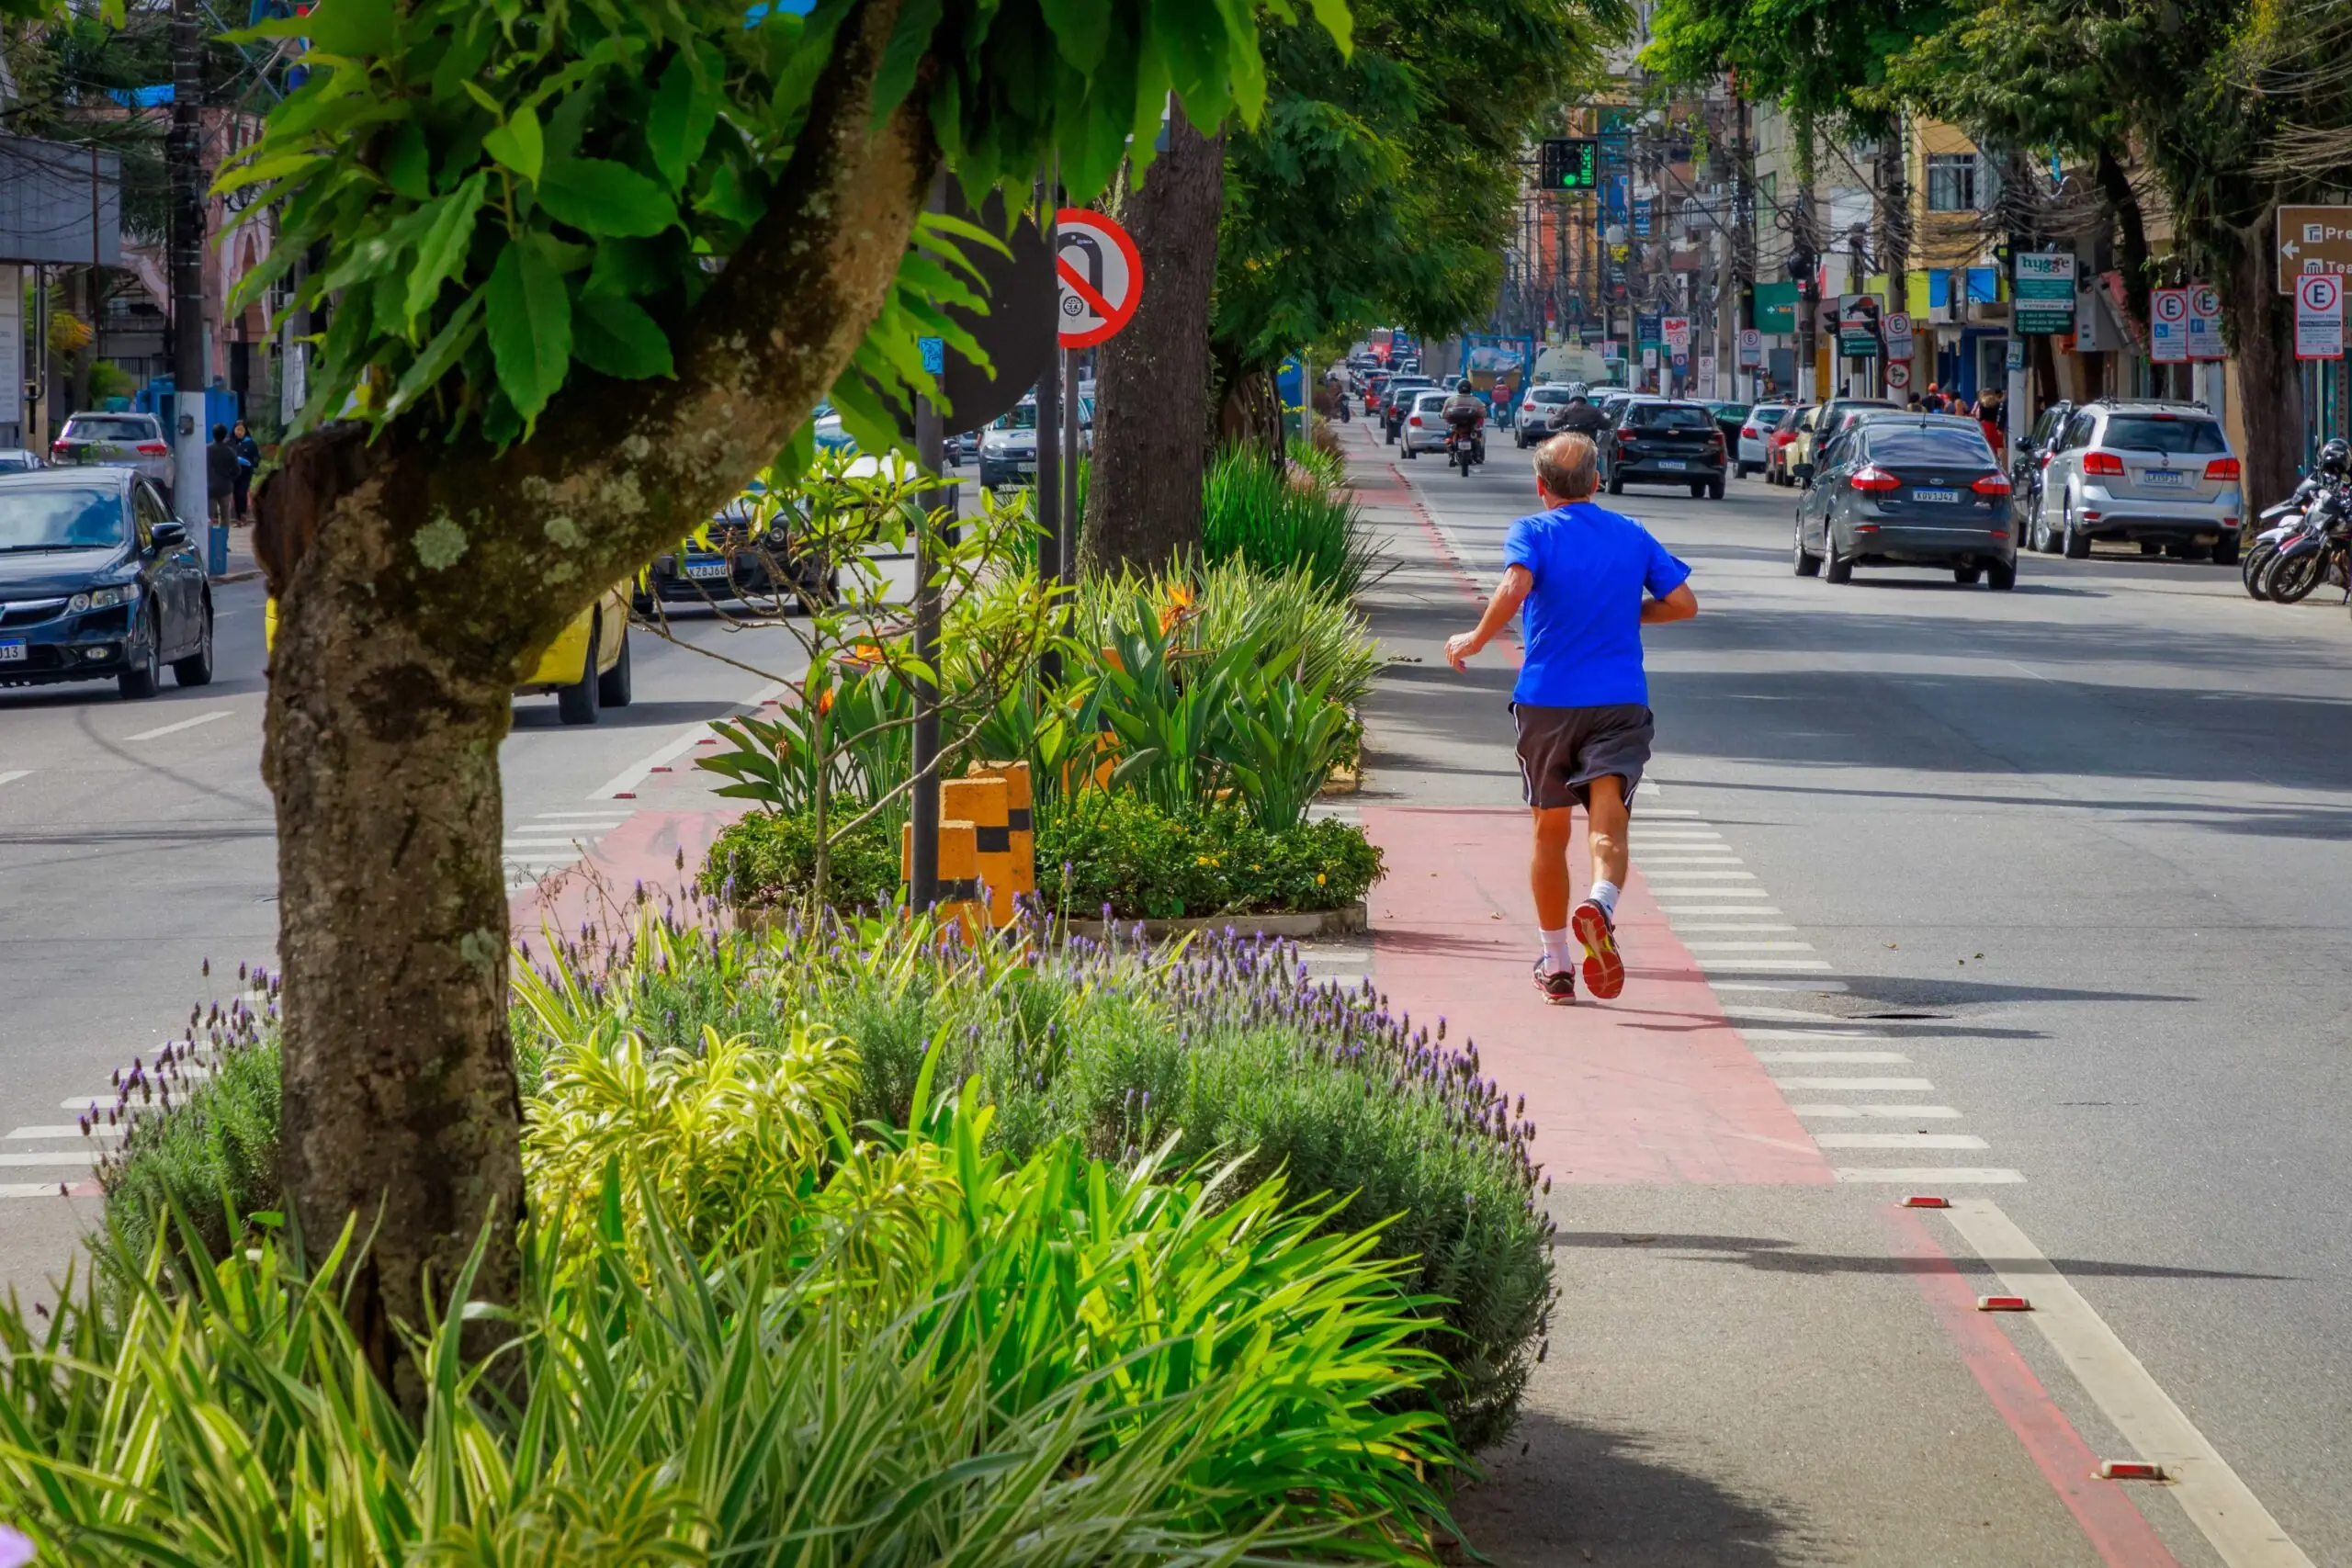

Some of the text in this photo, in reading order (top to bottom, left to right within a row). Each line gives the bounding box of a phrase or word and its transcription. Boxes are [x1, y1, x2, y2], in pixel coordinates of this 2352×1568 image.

[2021, 256, 2069, 273] hygge
[2202, 292, 2213, 310] E
[2314, 285, 2325, 303] E
[2165, 299, 2177, 315] E
[1894, 319, 1902, 330] E
